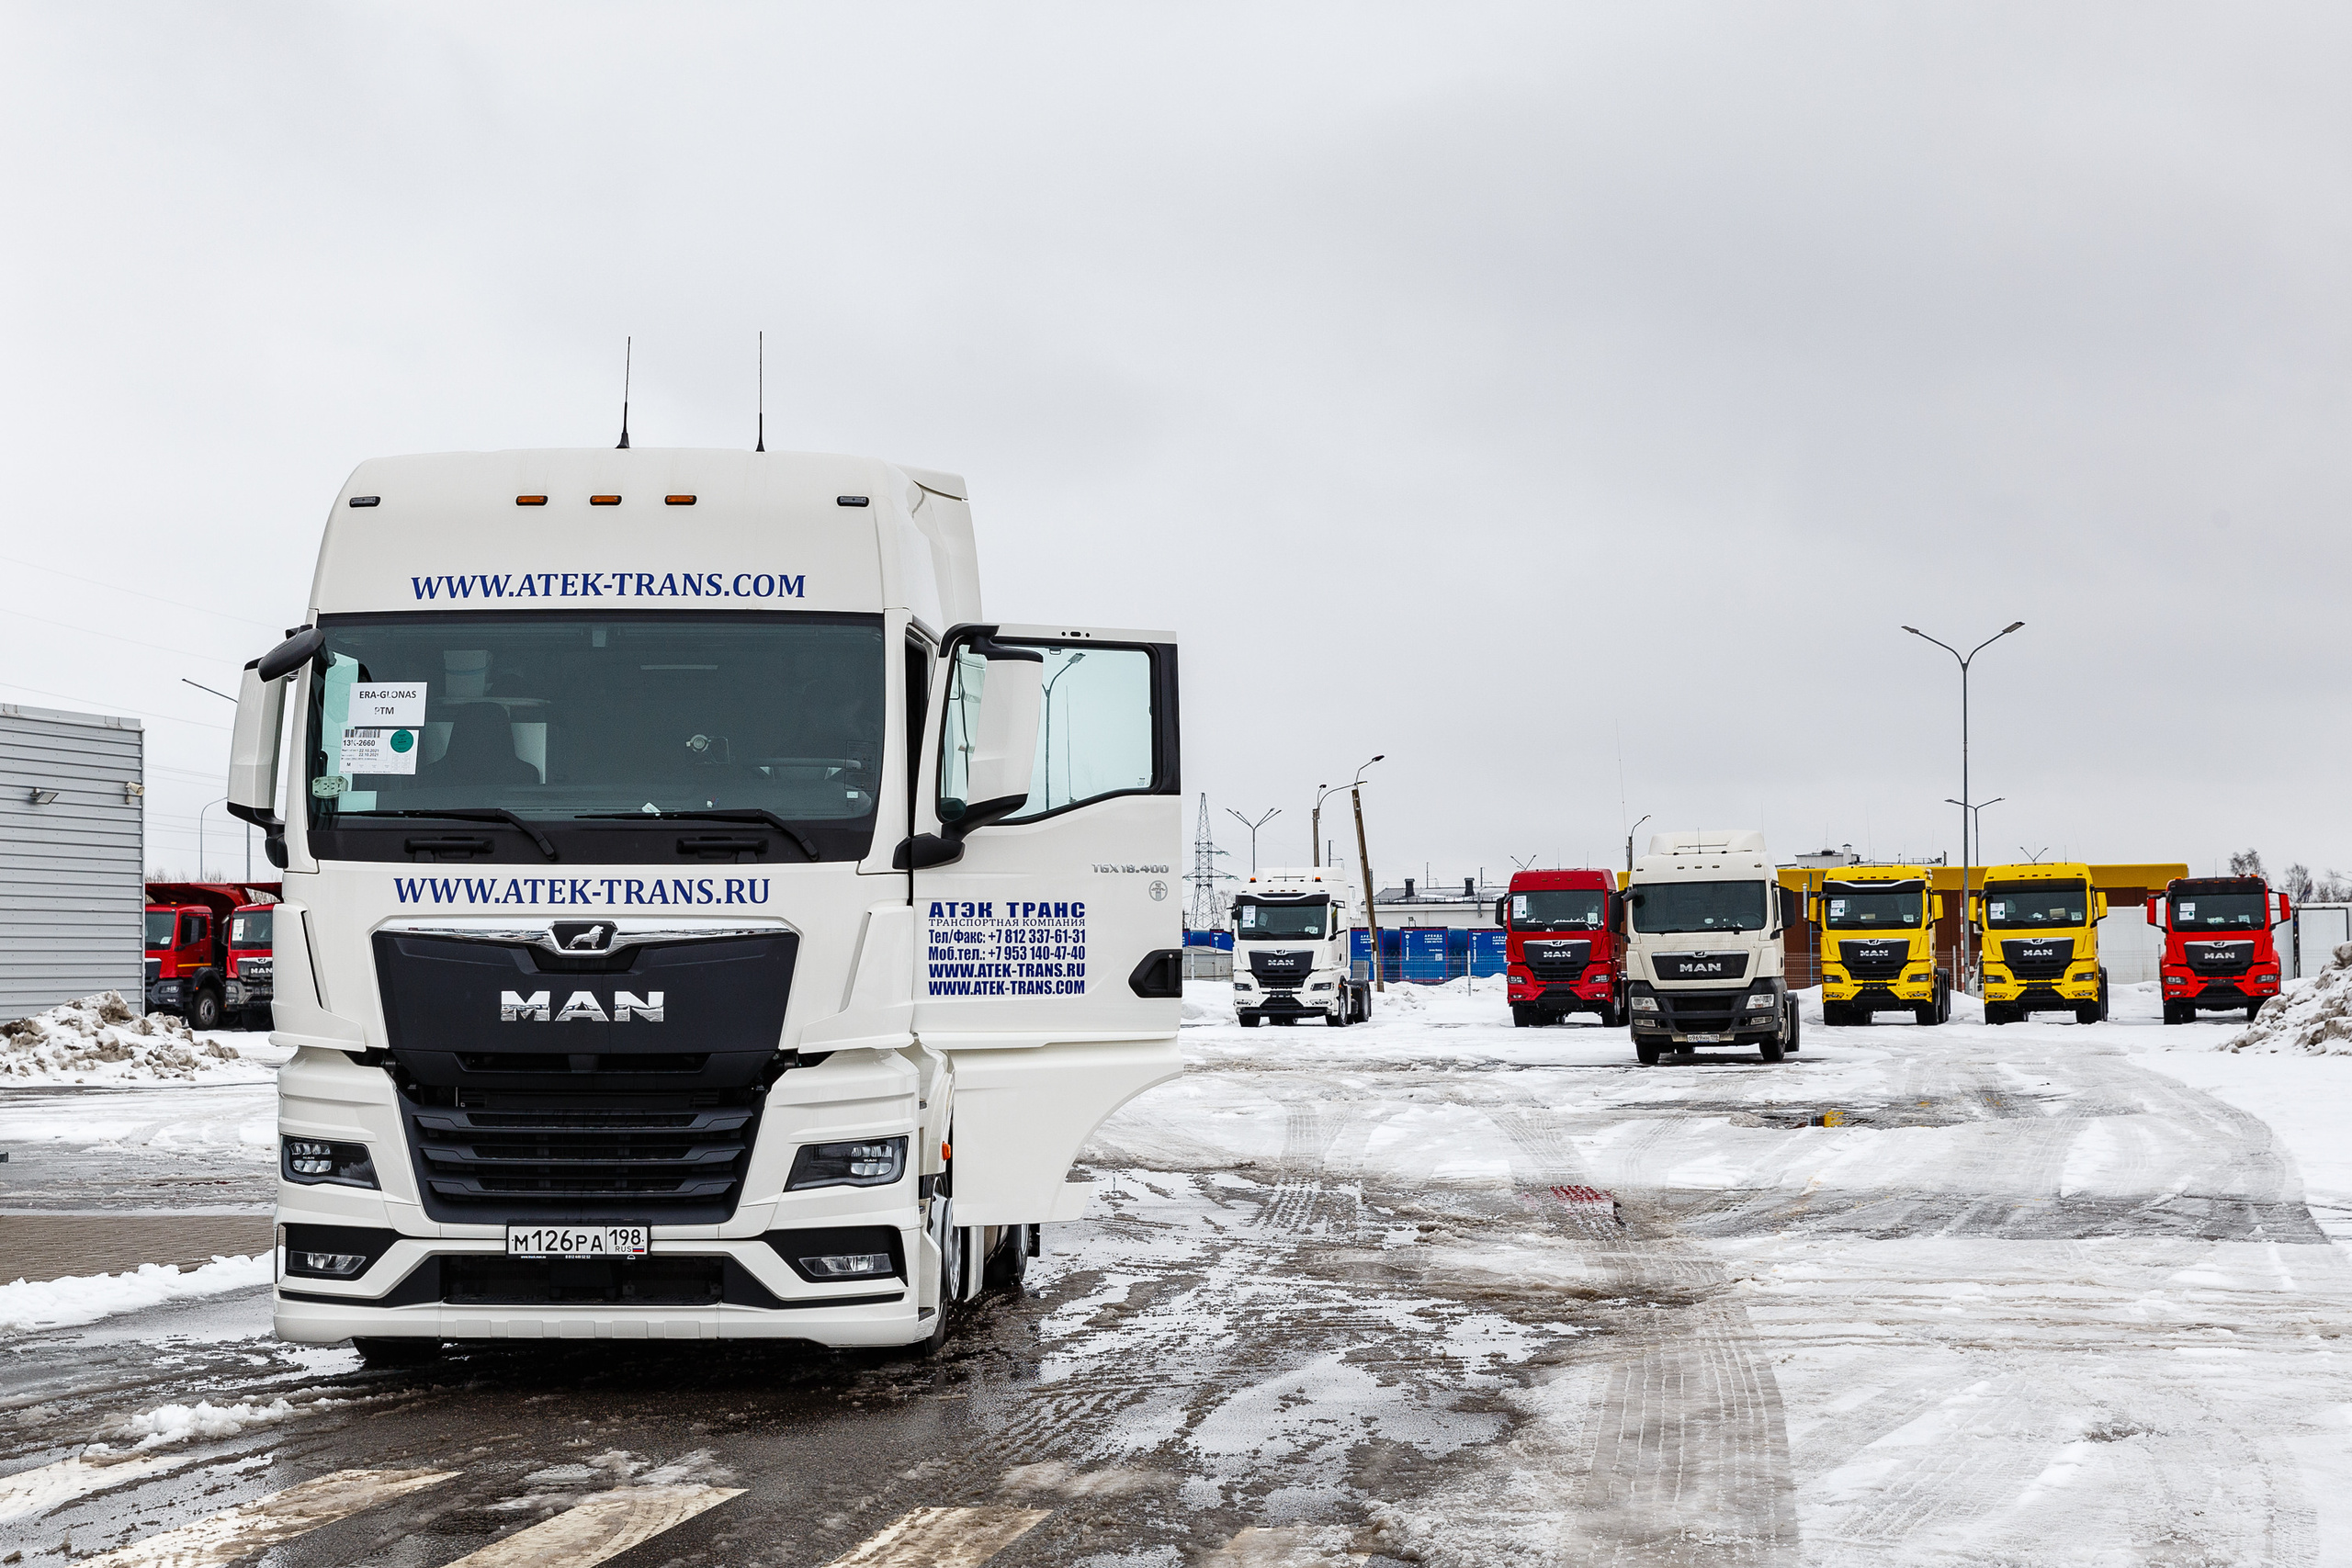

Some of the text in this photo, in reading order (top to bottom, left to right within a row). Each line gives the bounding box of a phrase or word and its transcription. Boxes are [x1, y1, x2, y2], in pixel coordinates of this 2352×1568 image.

[411, 572, 806, 600] WWW.ATEK-TRANS.COM
[393, 877, 771, 905] WWW.ATEK-TRANS.RU
[928, 901, 1086, 918] АТЭК ТРАНС
[928, 929, 986, 944] Тел/Факс:
[1005, 930, 1025, 943] 812
[1028, 929, 1086, 943] 337-61-31
[928, 946, 986, 961] Моб.тел.:
[1004, 946, 1026, 960] 953
[1030, 946, 1086, 960] 140-47-40
[928, 963, 1086, 978] WWW.ATEK-TRANS.RU
[1679, 963, 1721, 972] MAN
[928, 979, 1085, 996] WWW.ATEK-TRANS.COM
[501, 990, 664, 1022] MAN
[608, 1229, 640, 1246] 198
